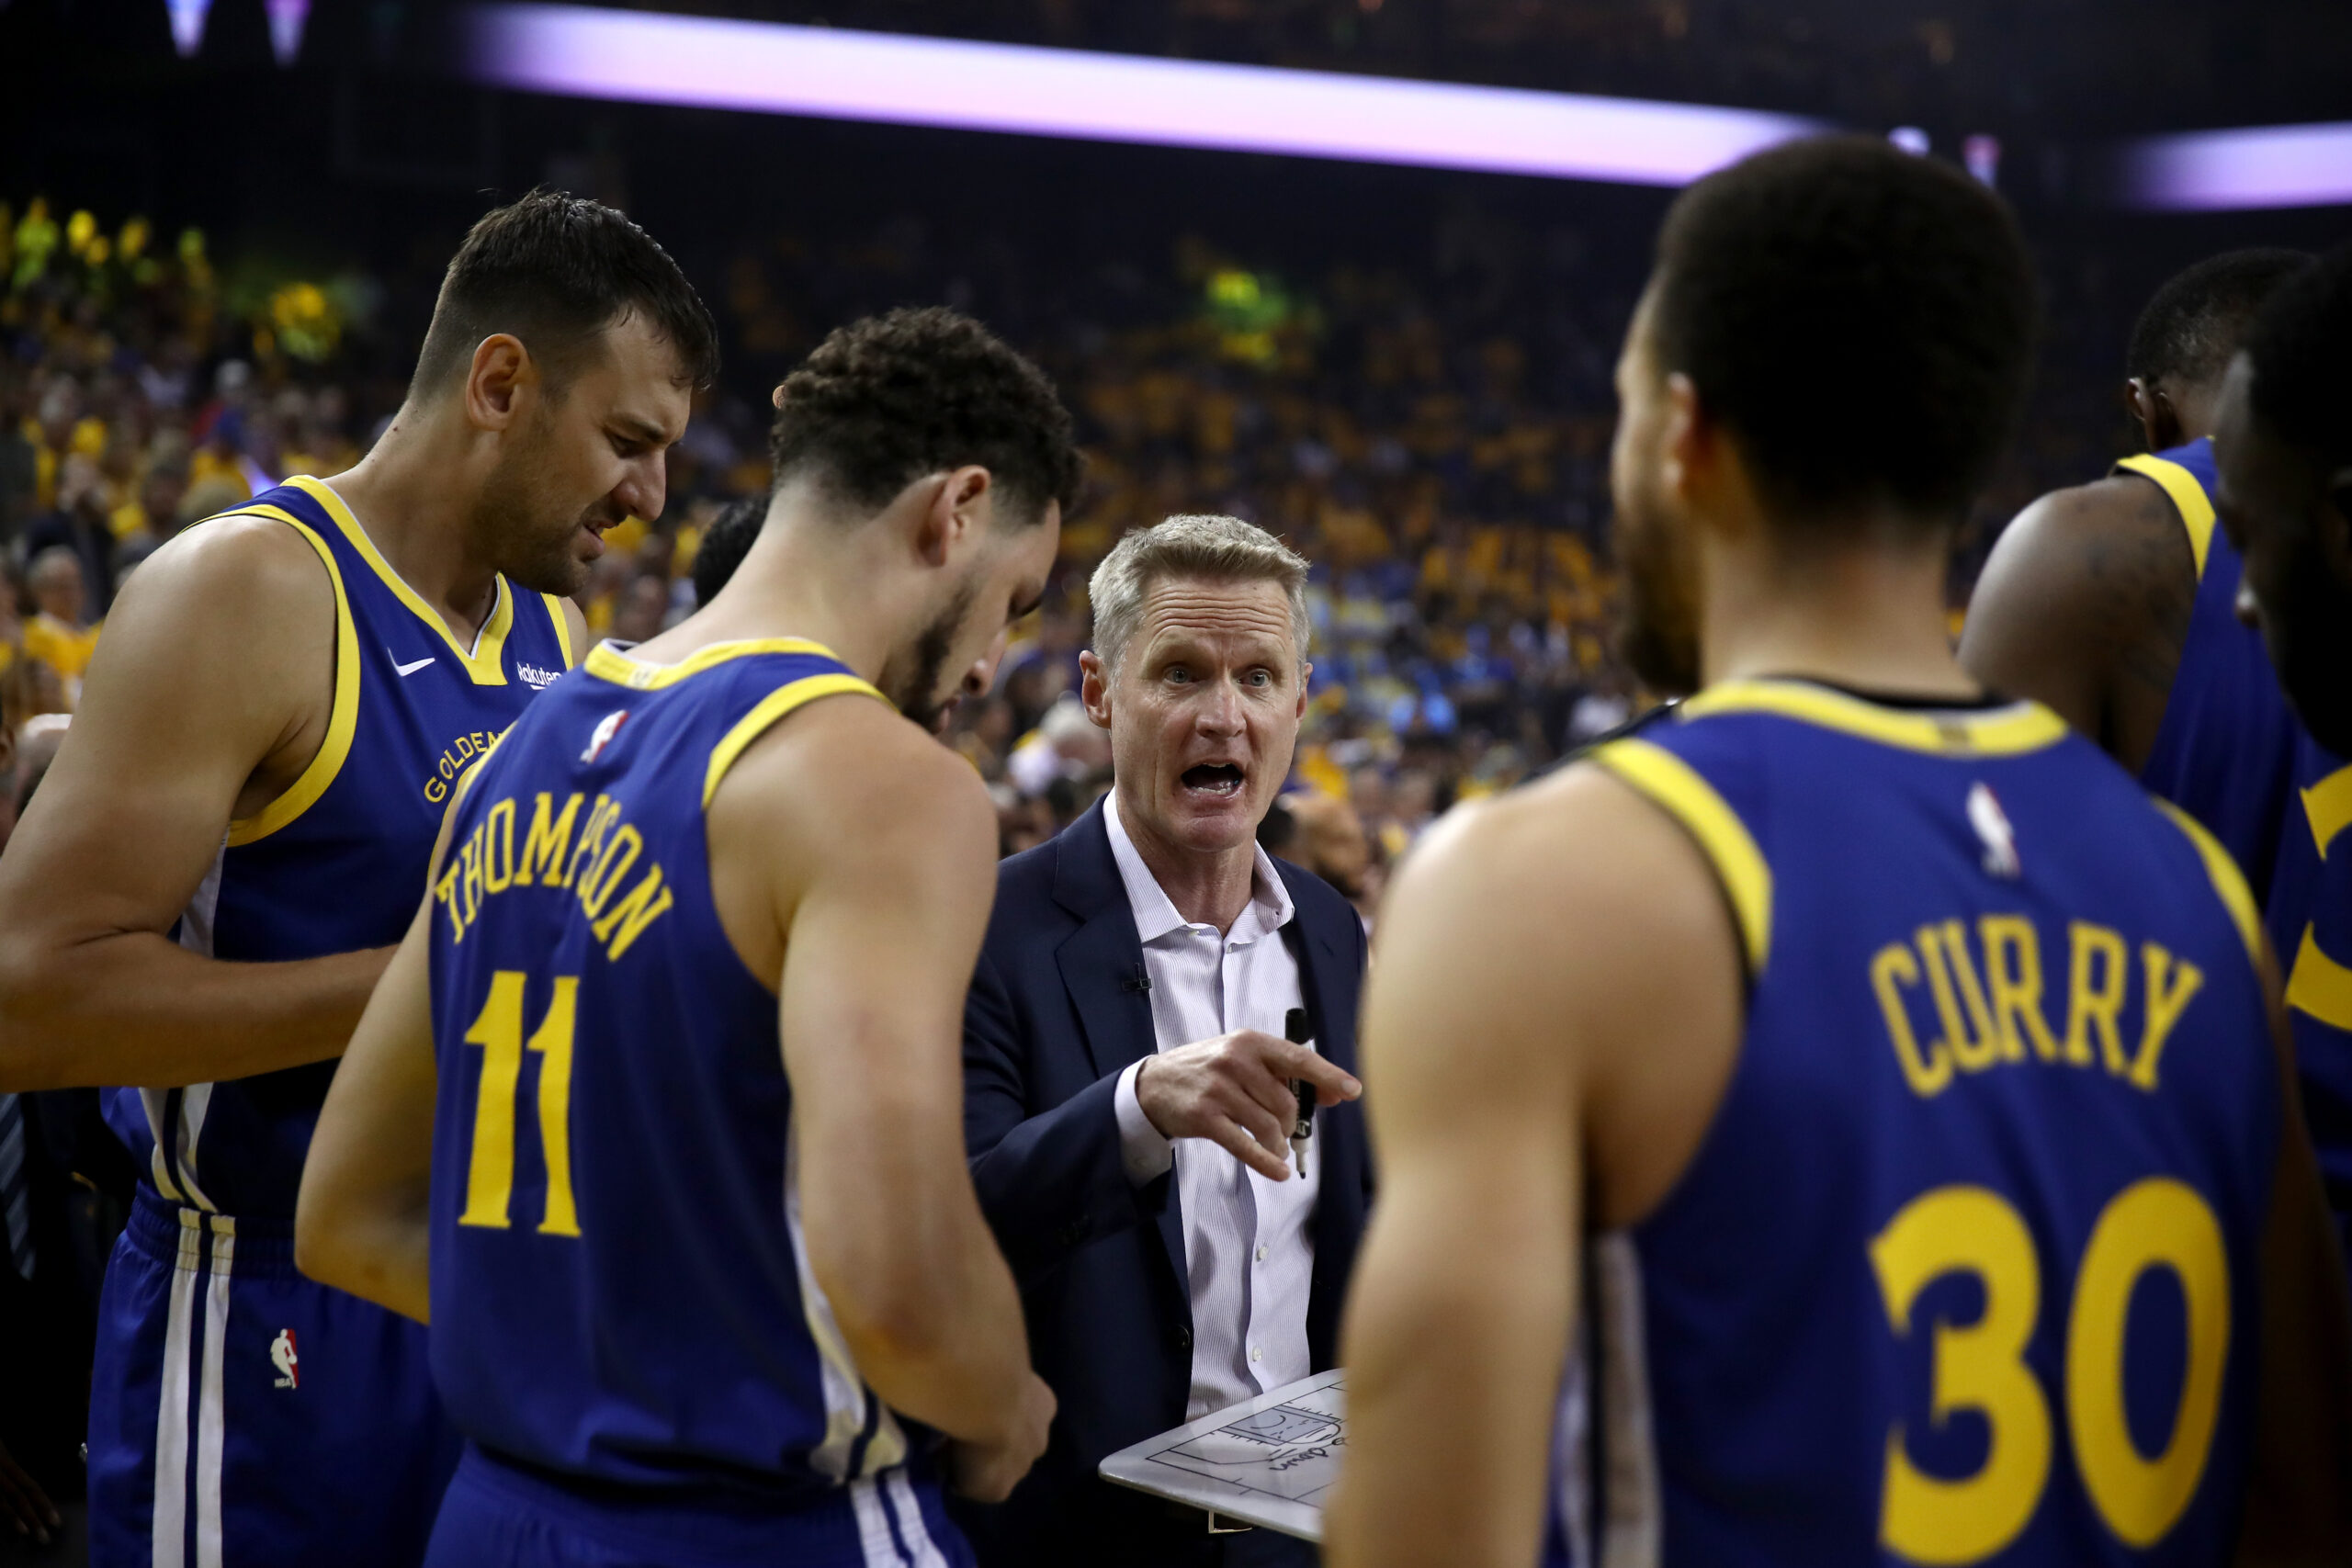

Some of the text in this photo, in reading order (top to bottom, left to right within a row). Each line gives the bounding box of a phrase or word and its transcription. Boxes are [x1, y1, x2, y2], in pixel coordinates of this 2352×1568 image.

[435, 792, 673, 962] THOMPSON
[458, 970, 582, 1237] 11
[1869, 913, 2203, 1098] CURRY
[1867, 1176, 2231, 1567] 30
